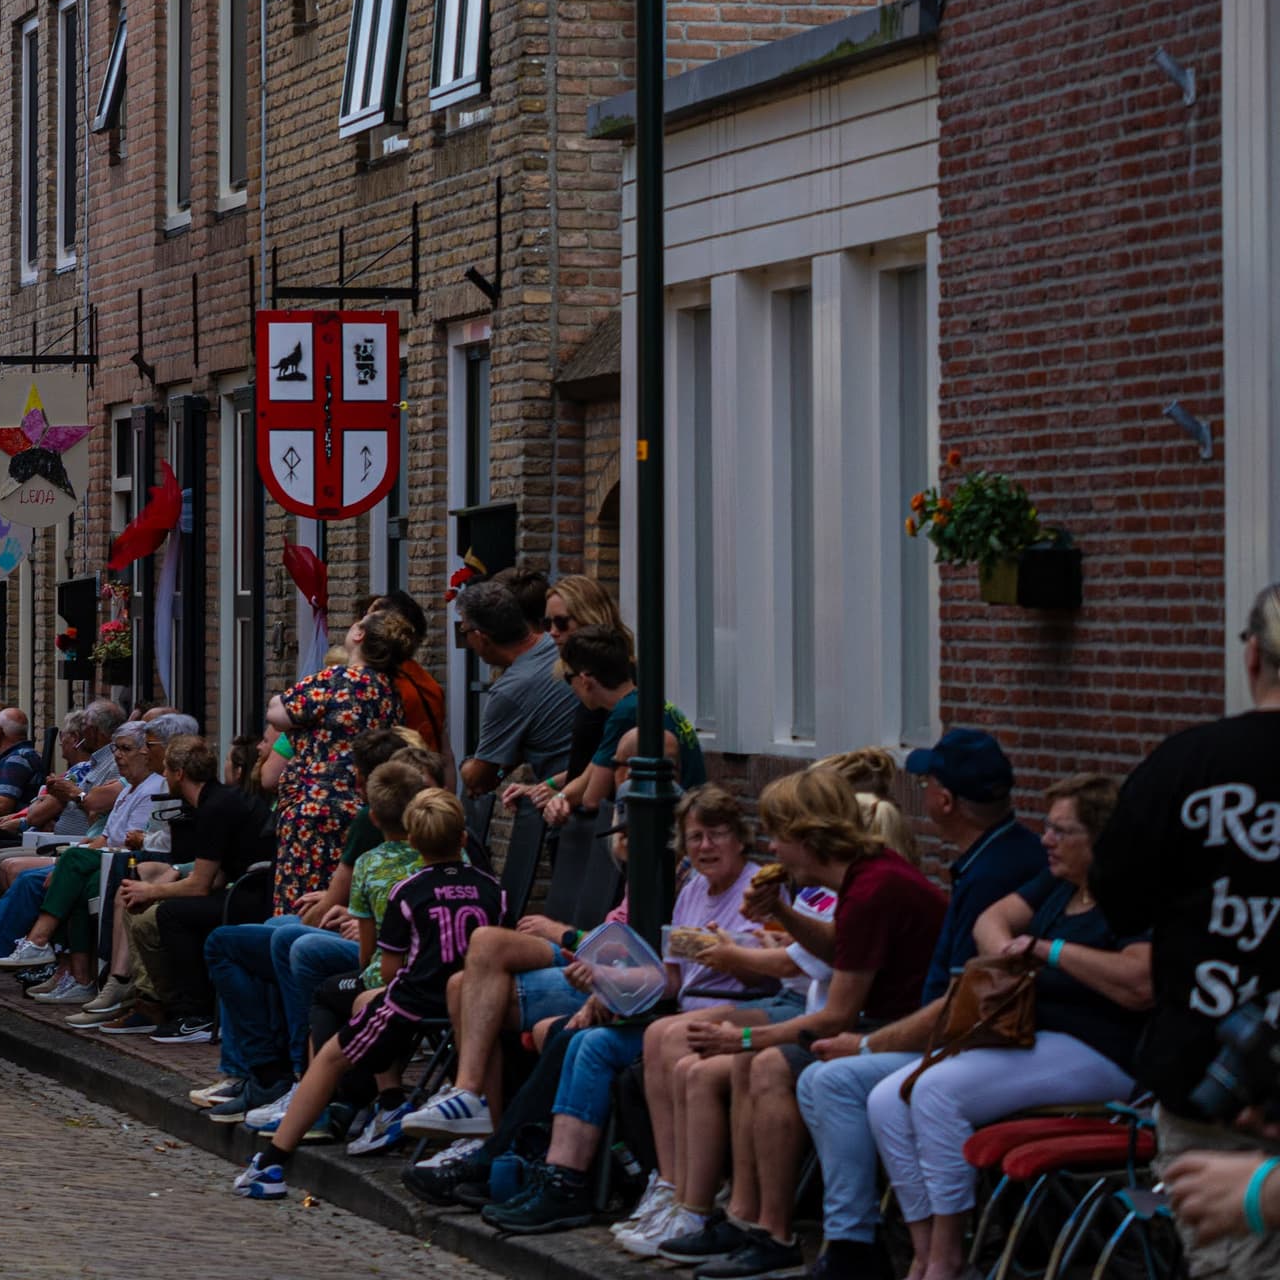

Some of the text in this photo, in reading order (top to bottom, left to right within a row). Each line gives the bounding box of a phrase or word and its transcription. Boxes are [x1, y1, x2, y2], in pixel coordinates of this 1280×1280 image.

[434, 885, 479, 900] MESSI
[1208, 876, 1280, 951] by
[428, 905, 488, 963] 10
